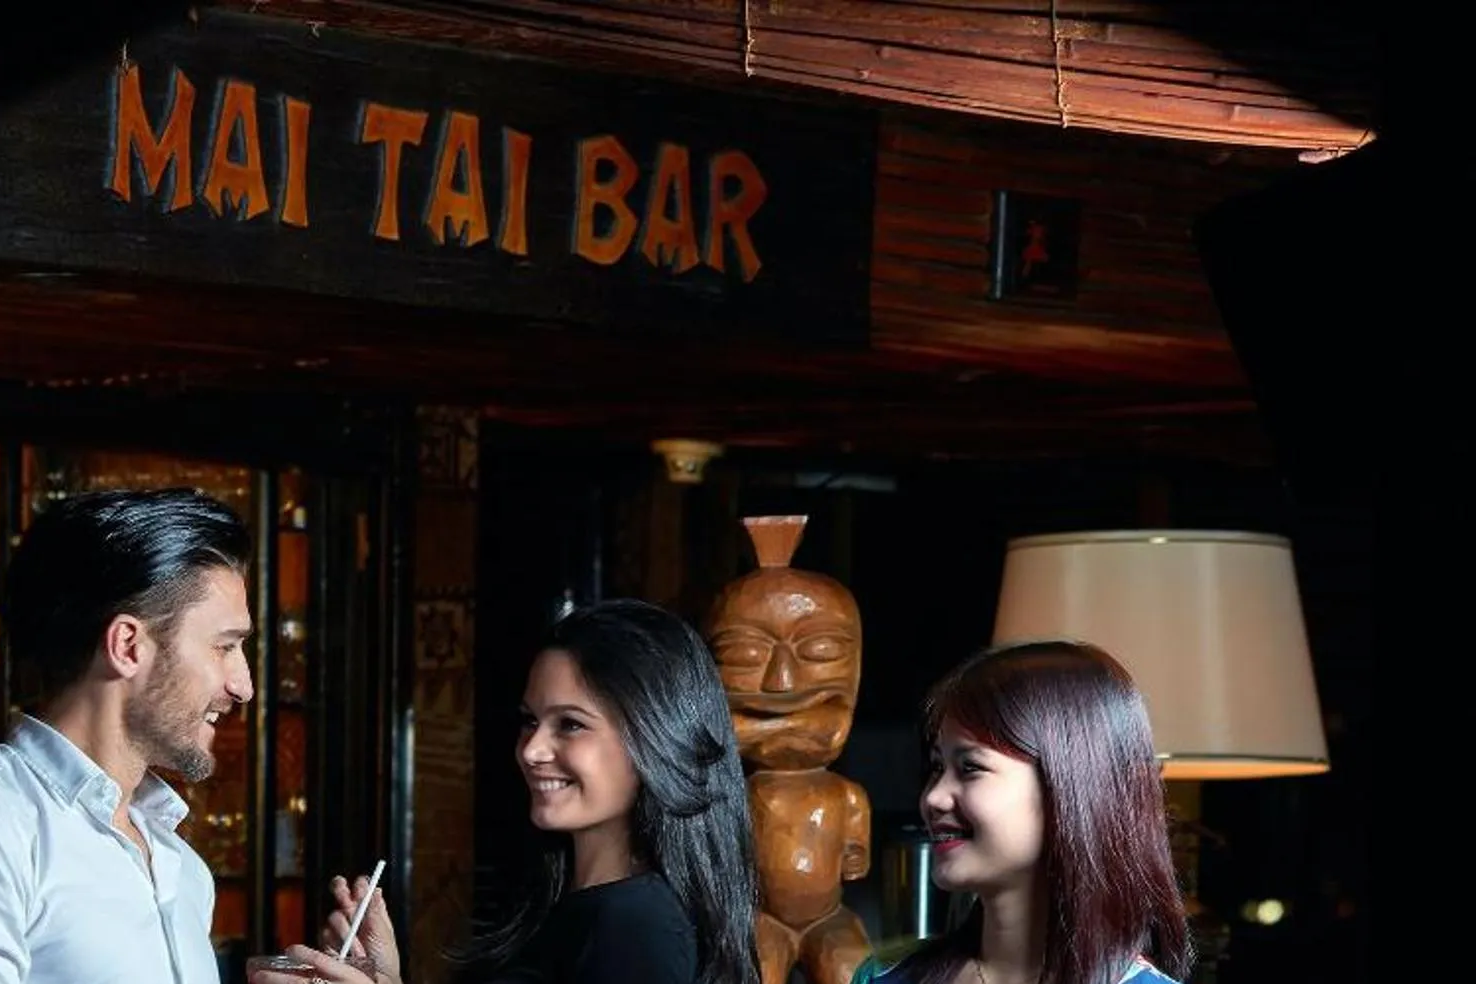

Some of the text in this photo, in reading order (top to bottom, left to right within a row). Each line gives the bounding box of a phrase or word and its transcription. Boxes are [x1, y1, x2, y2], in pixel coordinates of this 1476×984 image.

[103, 64, 768, 285] MAI TAI BAR
